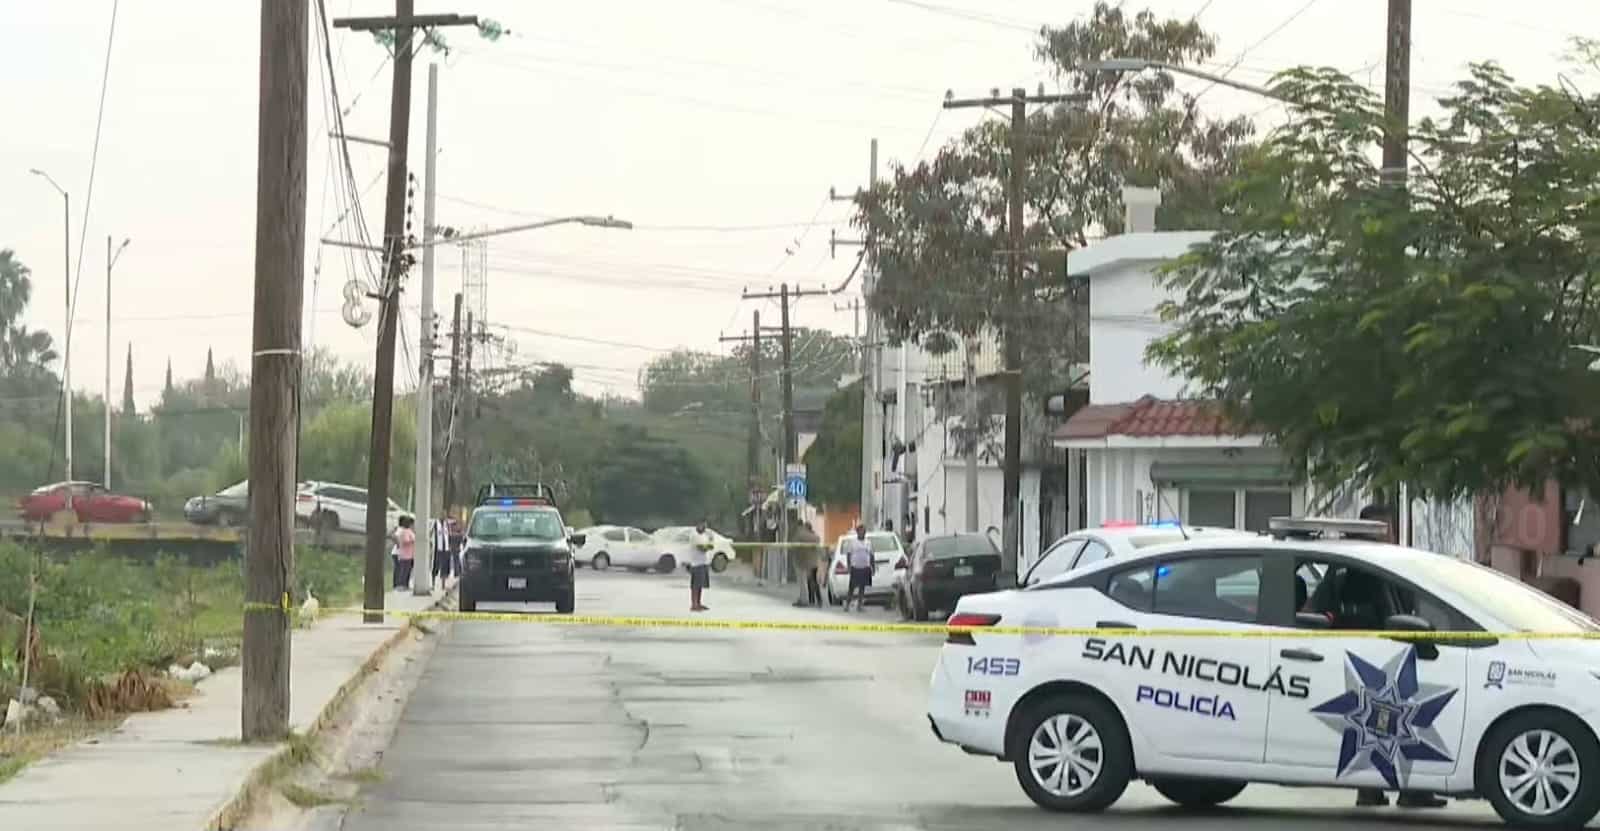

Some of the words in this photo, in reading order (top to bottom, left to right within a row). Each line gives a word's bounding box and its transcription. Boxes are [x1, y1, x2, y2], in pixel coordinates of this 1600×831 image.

[788, 480, 804, 497] 40
[967, 656, 1021, 676] 1453
[1082, 638, 1154, 670] SAN
[1162, 650, 1311, 699] NICOLÁS
[1136, 685, 1236, 721] POLICÍA
